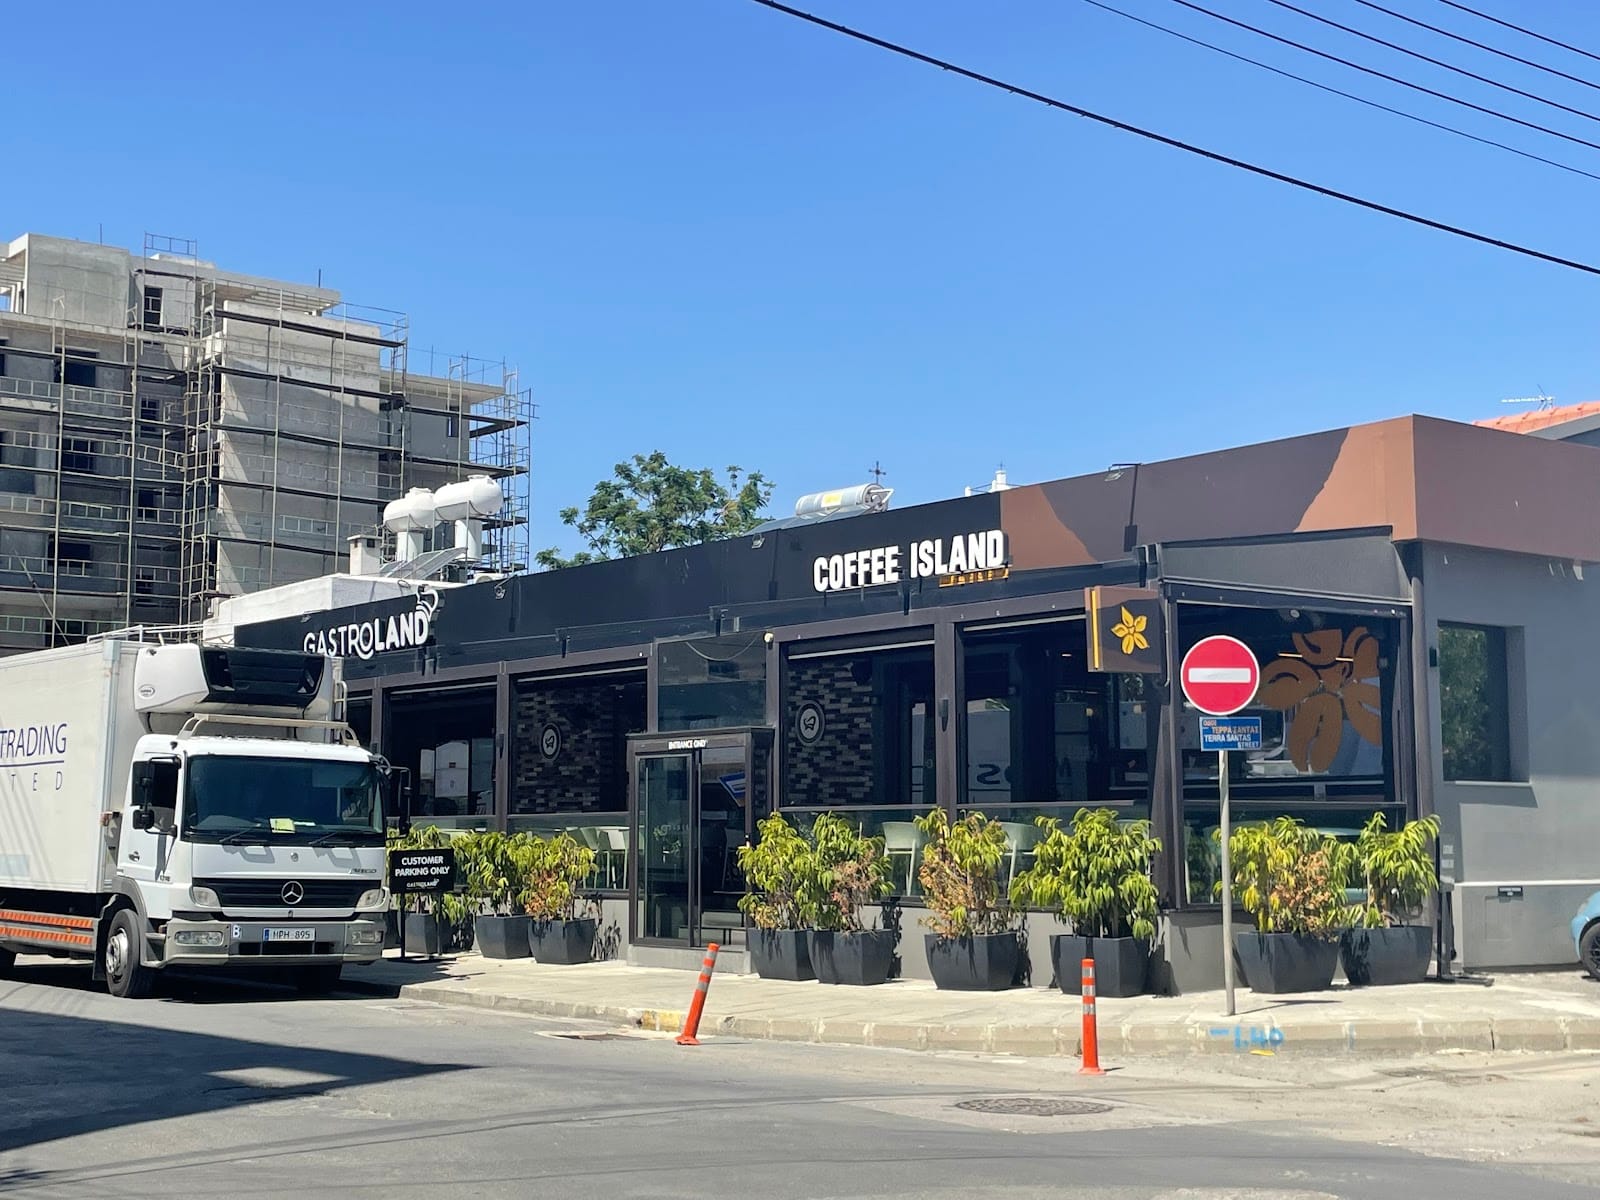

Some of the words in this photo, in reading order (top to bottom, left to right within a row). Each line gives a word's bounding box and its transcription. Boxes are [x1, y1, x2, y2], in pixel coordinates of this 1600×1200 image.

[814, 545, 900, 592] COFFEE
[910, 530, 1005, 579] ISLAND
[304, 610, 429, 660] GASTROLAND
[0, 723, 67, 759] TRADING
[1204, 734, 1226, 743] TERRA
[1227, 733, 1252, 742] SANTAS
[1237, 741, 1259, 749] STREET
[401, 855, 444, 866] CUSTOMER
[395, 867, 429, 877] PARKING
[430, 866, 450, 875] ONLY
[294, 930, 311, 940] 895
